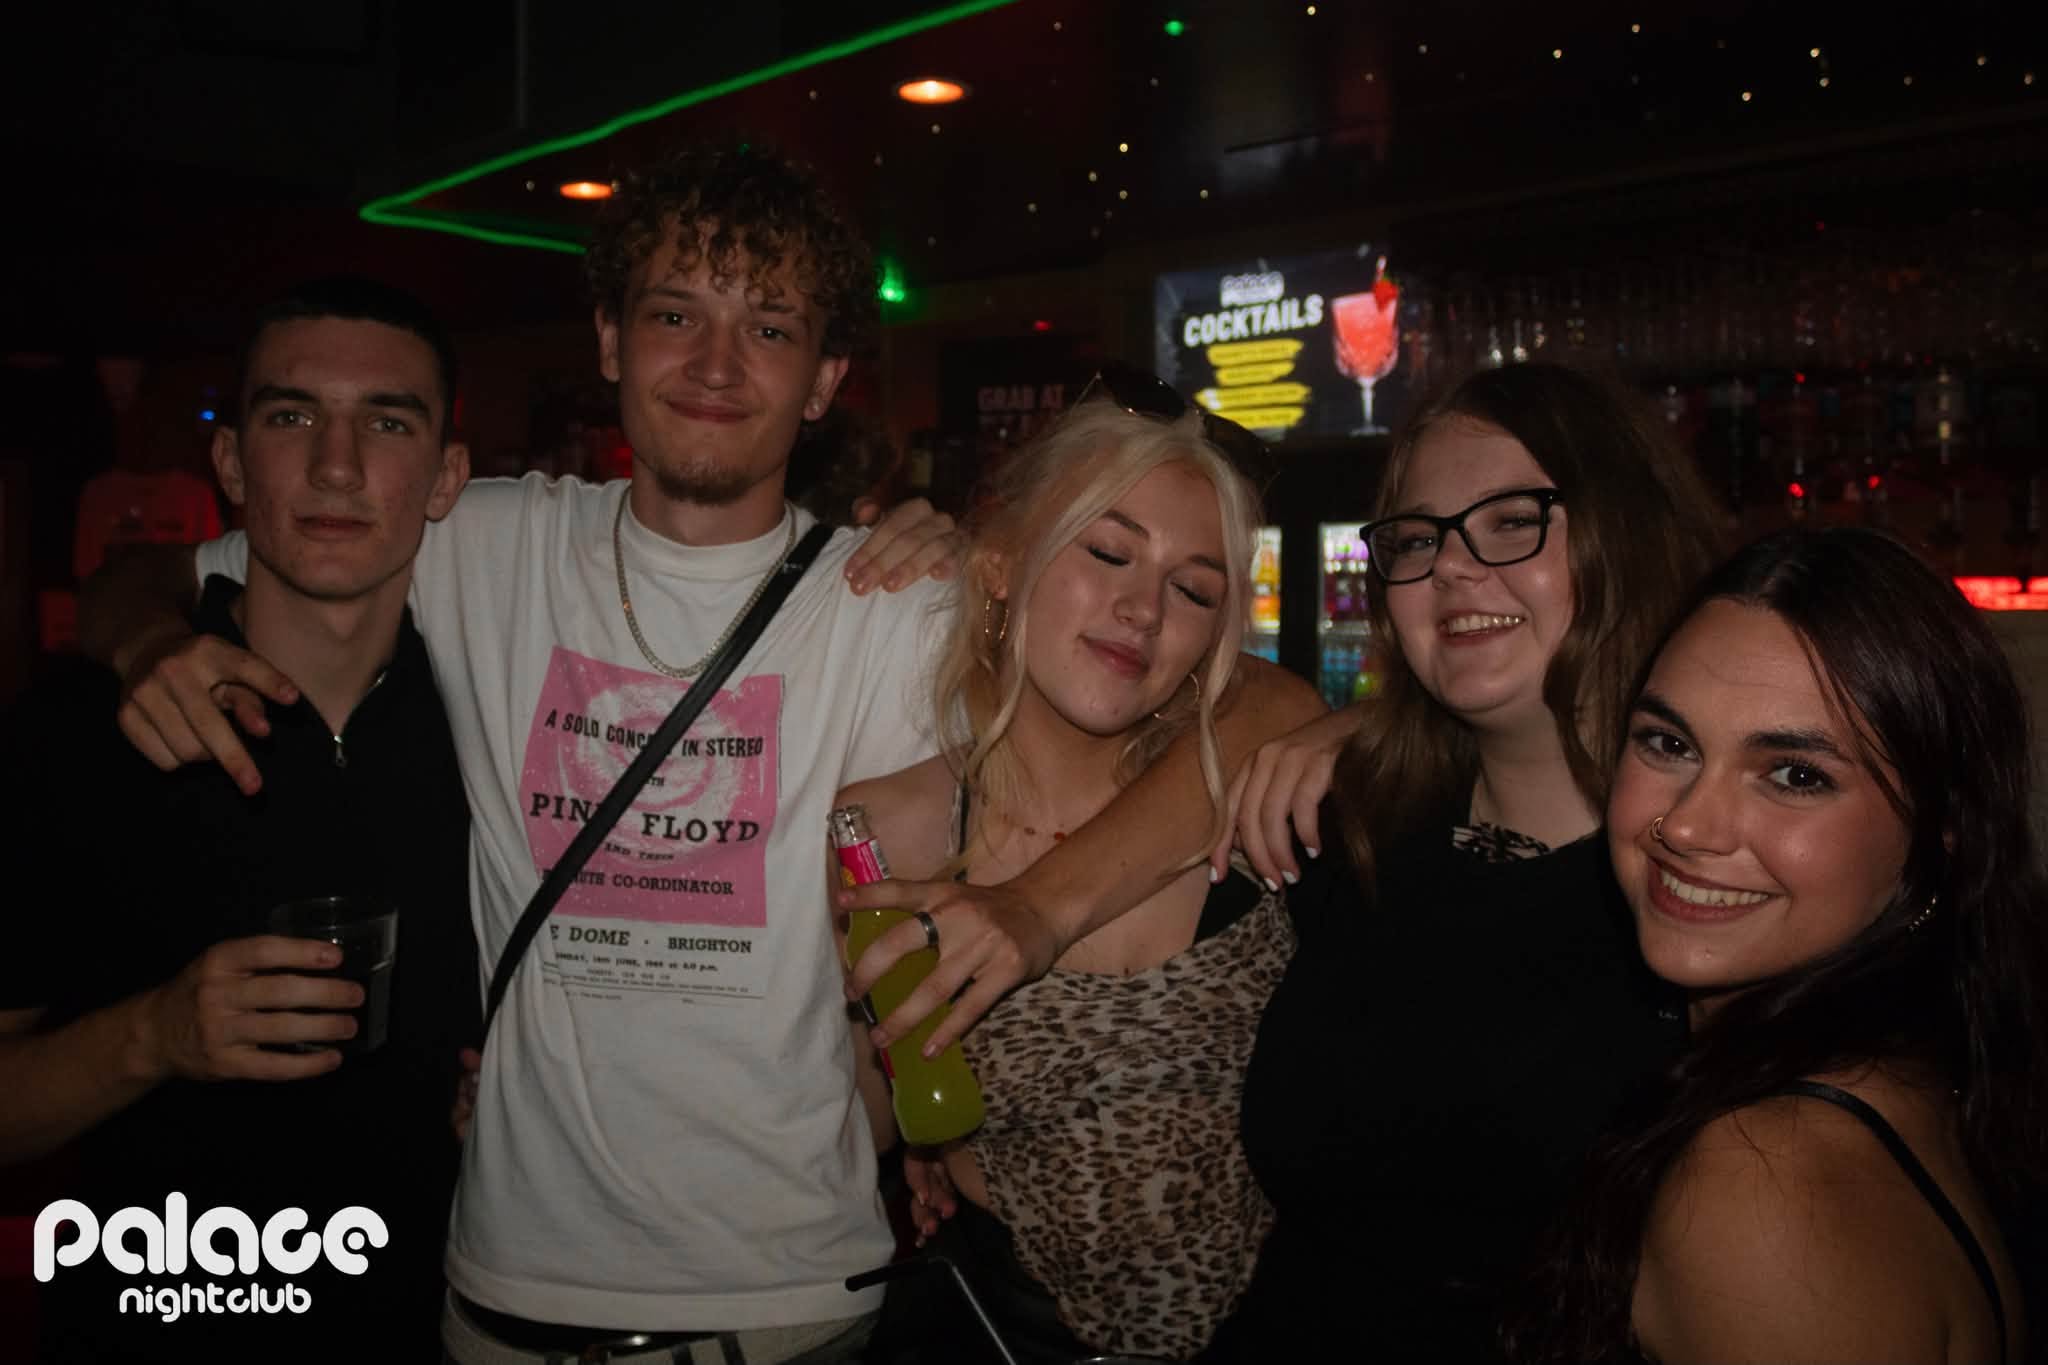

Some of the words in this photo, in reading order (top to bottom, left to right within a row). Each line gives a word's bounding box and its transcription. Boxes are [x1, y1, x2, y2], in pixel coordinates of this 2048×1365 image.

[1184, 294, 1324, 348] COCKTAILS
[545, 709, 558, 728] A
[562, 713, 600, 739] SOLO
[682, 740, 700, 756] IN
[706, 737, 764, 757] STEREO
[529, 792, 602, 822] PIN
[641, 812, 760, 843] FLOYD
[612, 874, 734, 895] CO-ORDINATOR
[569, 927, 631, 947] DOME
[668, 937, 753, 954] BRIGHTON
